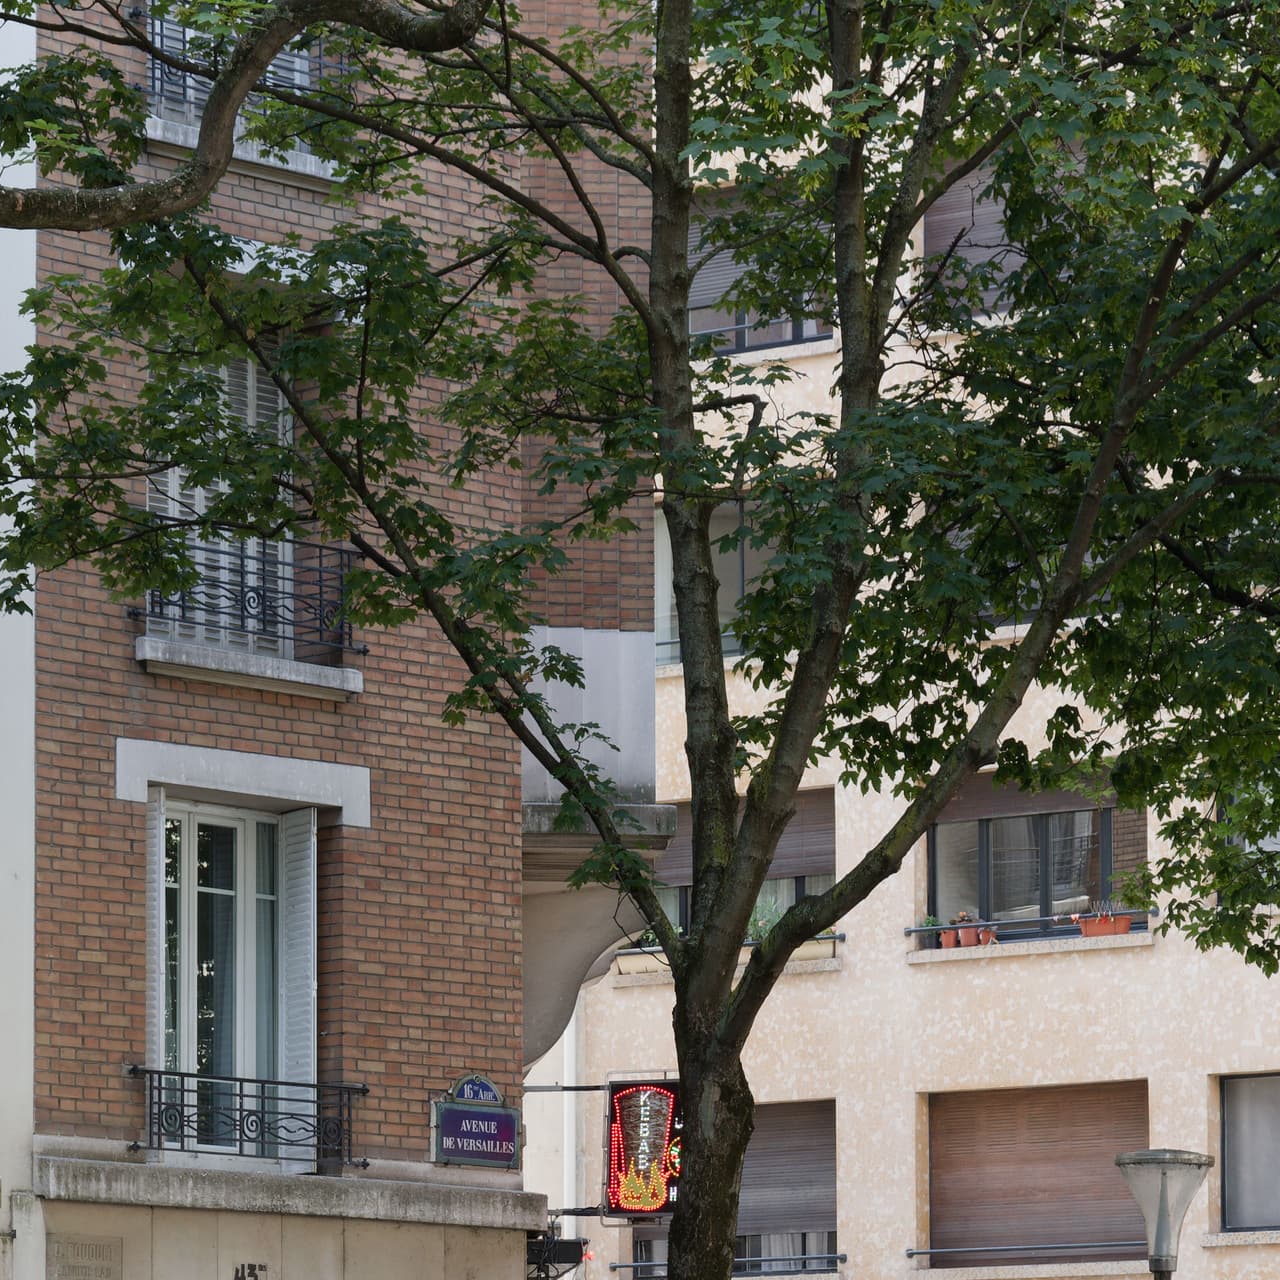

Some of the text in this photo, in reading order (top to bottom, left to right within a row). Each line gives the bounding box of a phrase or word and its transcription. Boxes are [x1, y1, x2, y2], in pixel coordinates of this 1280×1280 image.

[460, 1120, 497, 1133] AVENUE
[639, 1090, 650, 1170] KEBAB
[443, 1137, 515, 1153] DE VERSAILLES
